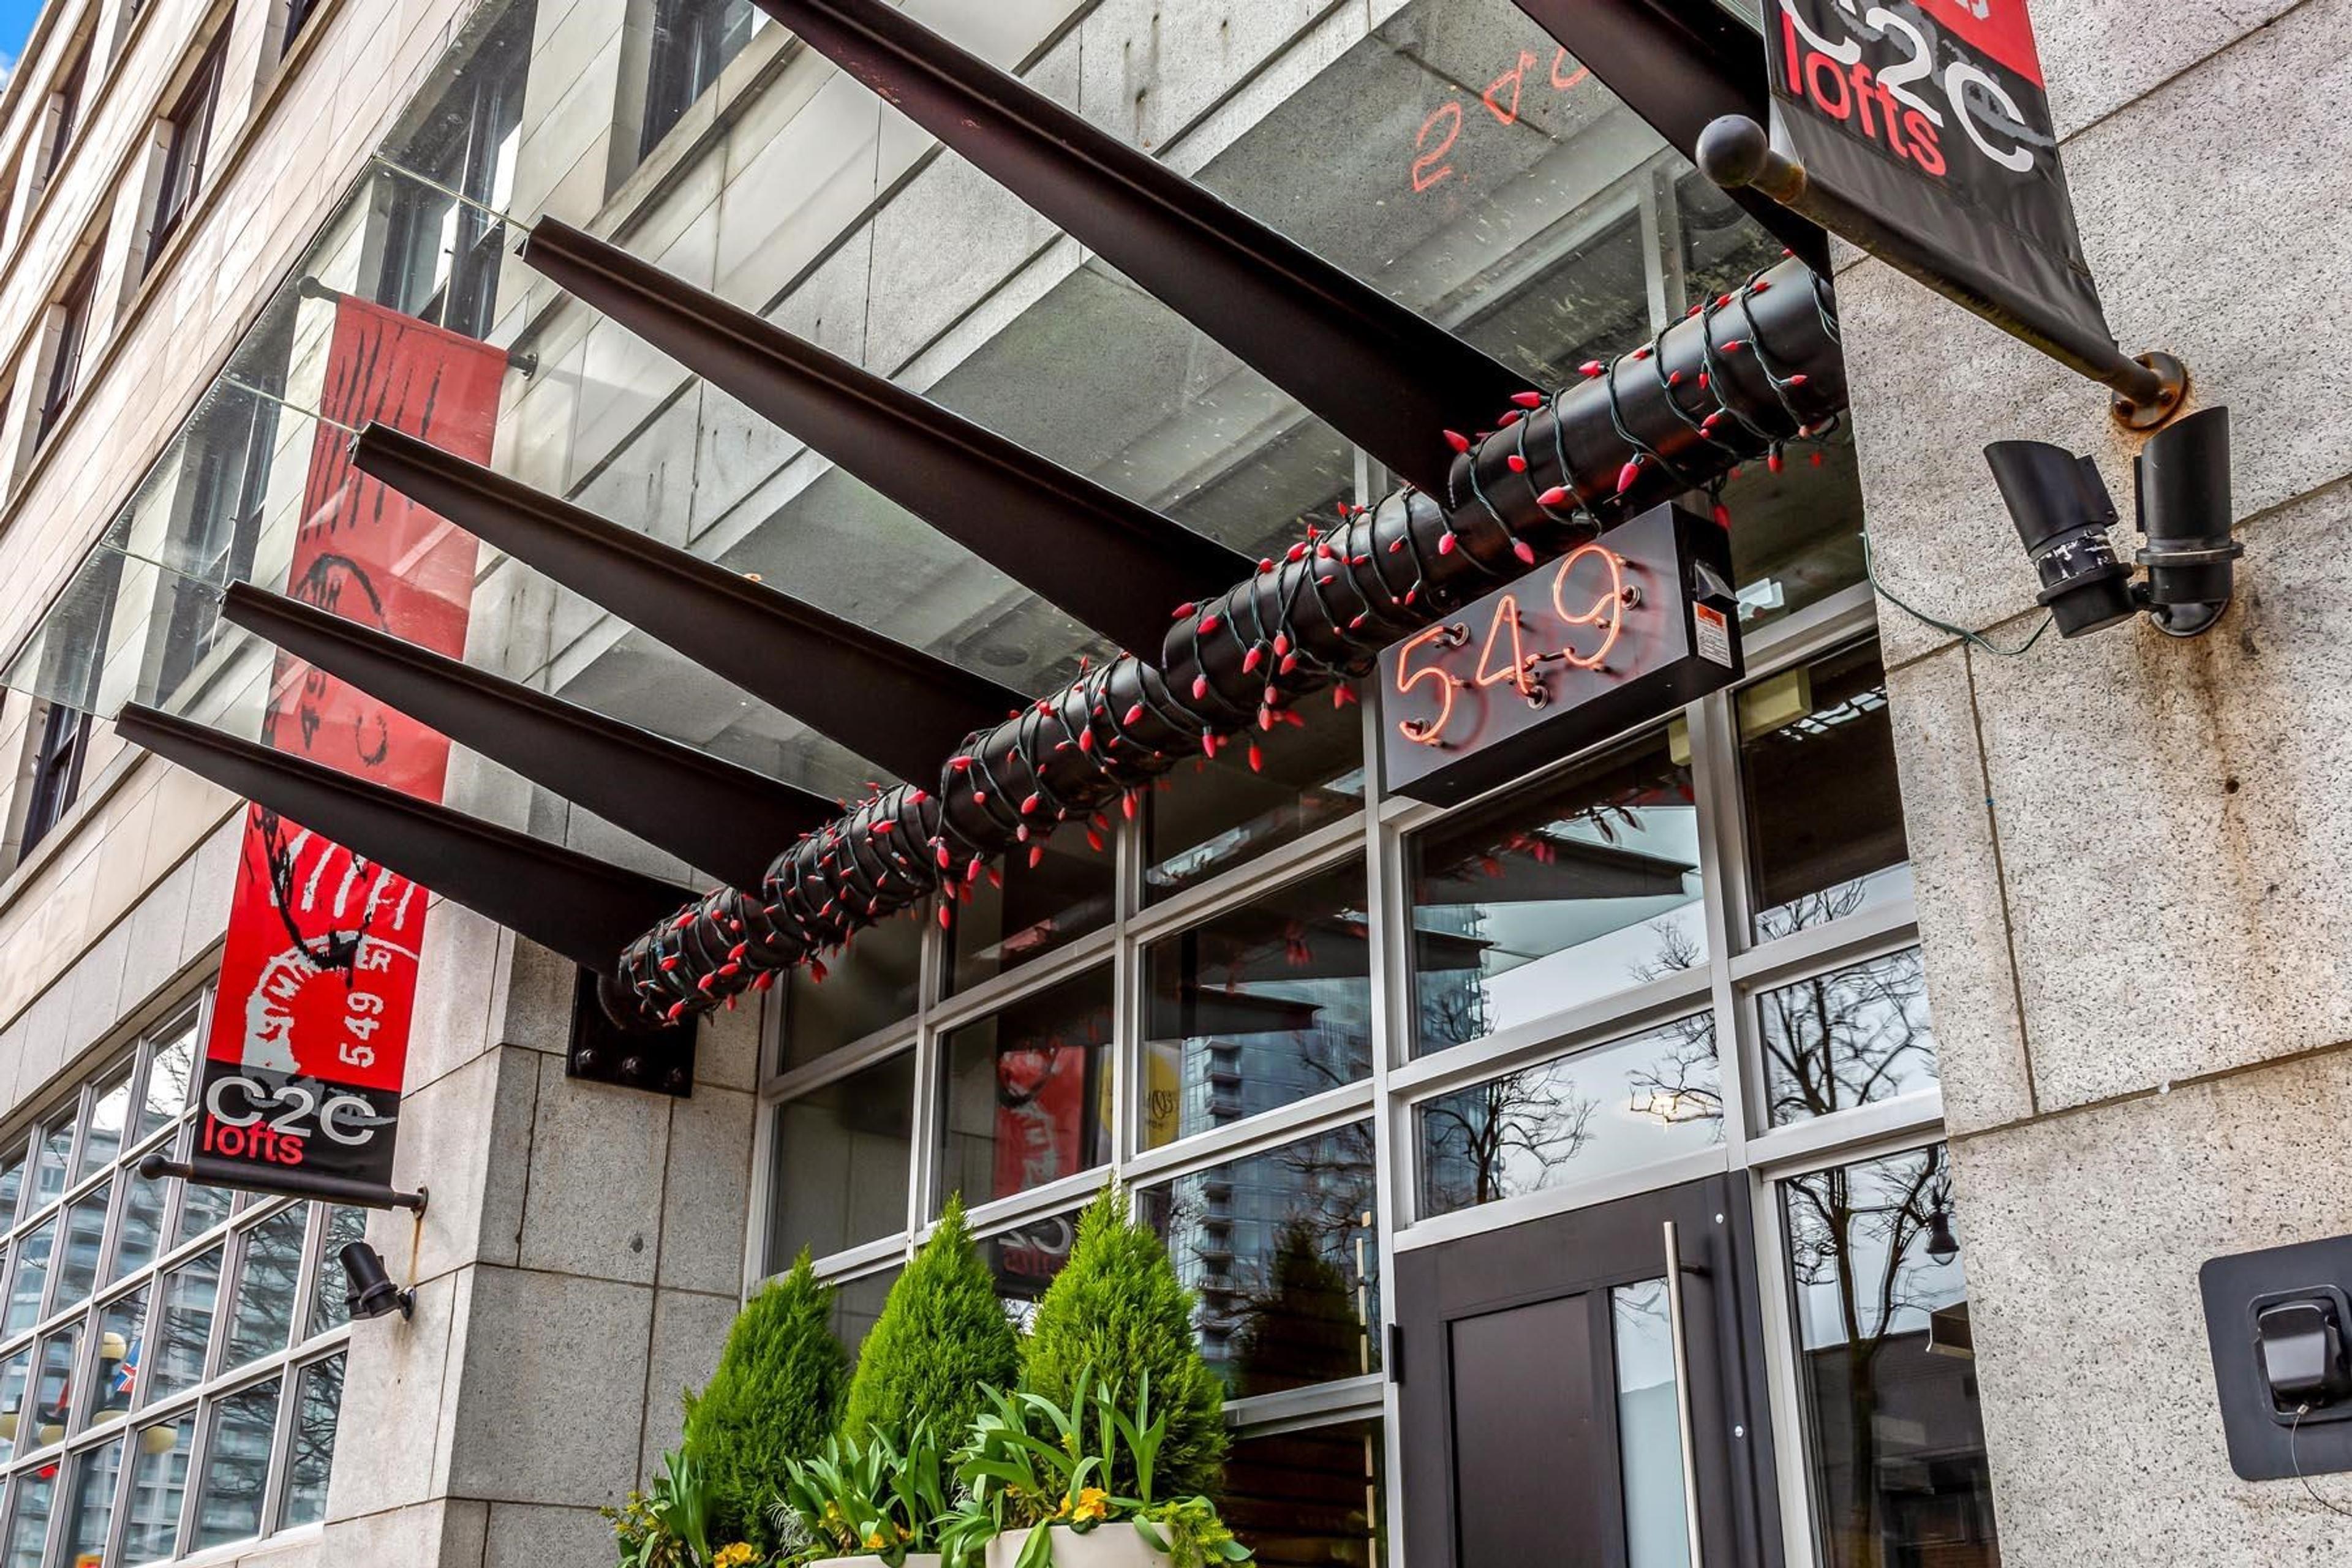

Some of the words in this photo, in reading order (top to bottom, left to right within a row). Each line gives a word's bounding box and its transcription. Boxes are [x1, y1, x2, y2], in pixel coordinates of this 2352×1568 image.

[1781, 9, 1947, 176] lofts
[1397, 542, 1622, 742] 549
[339, 992, 383, 1068] 549
[203, 1112, 304, 1165] lofts
[206, 1076, 376, 1145] C2C
